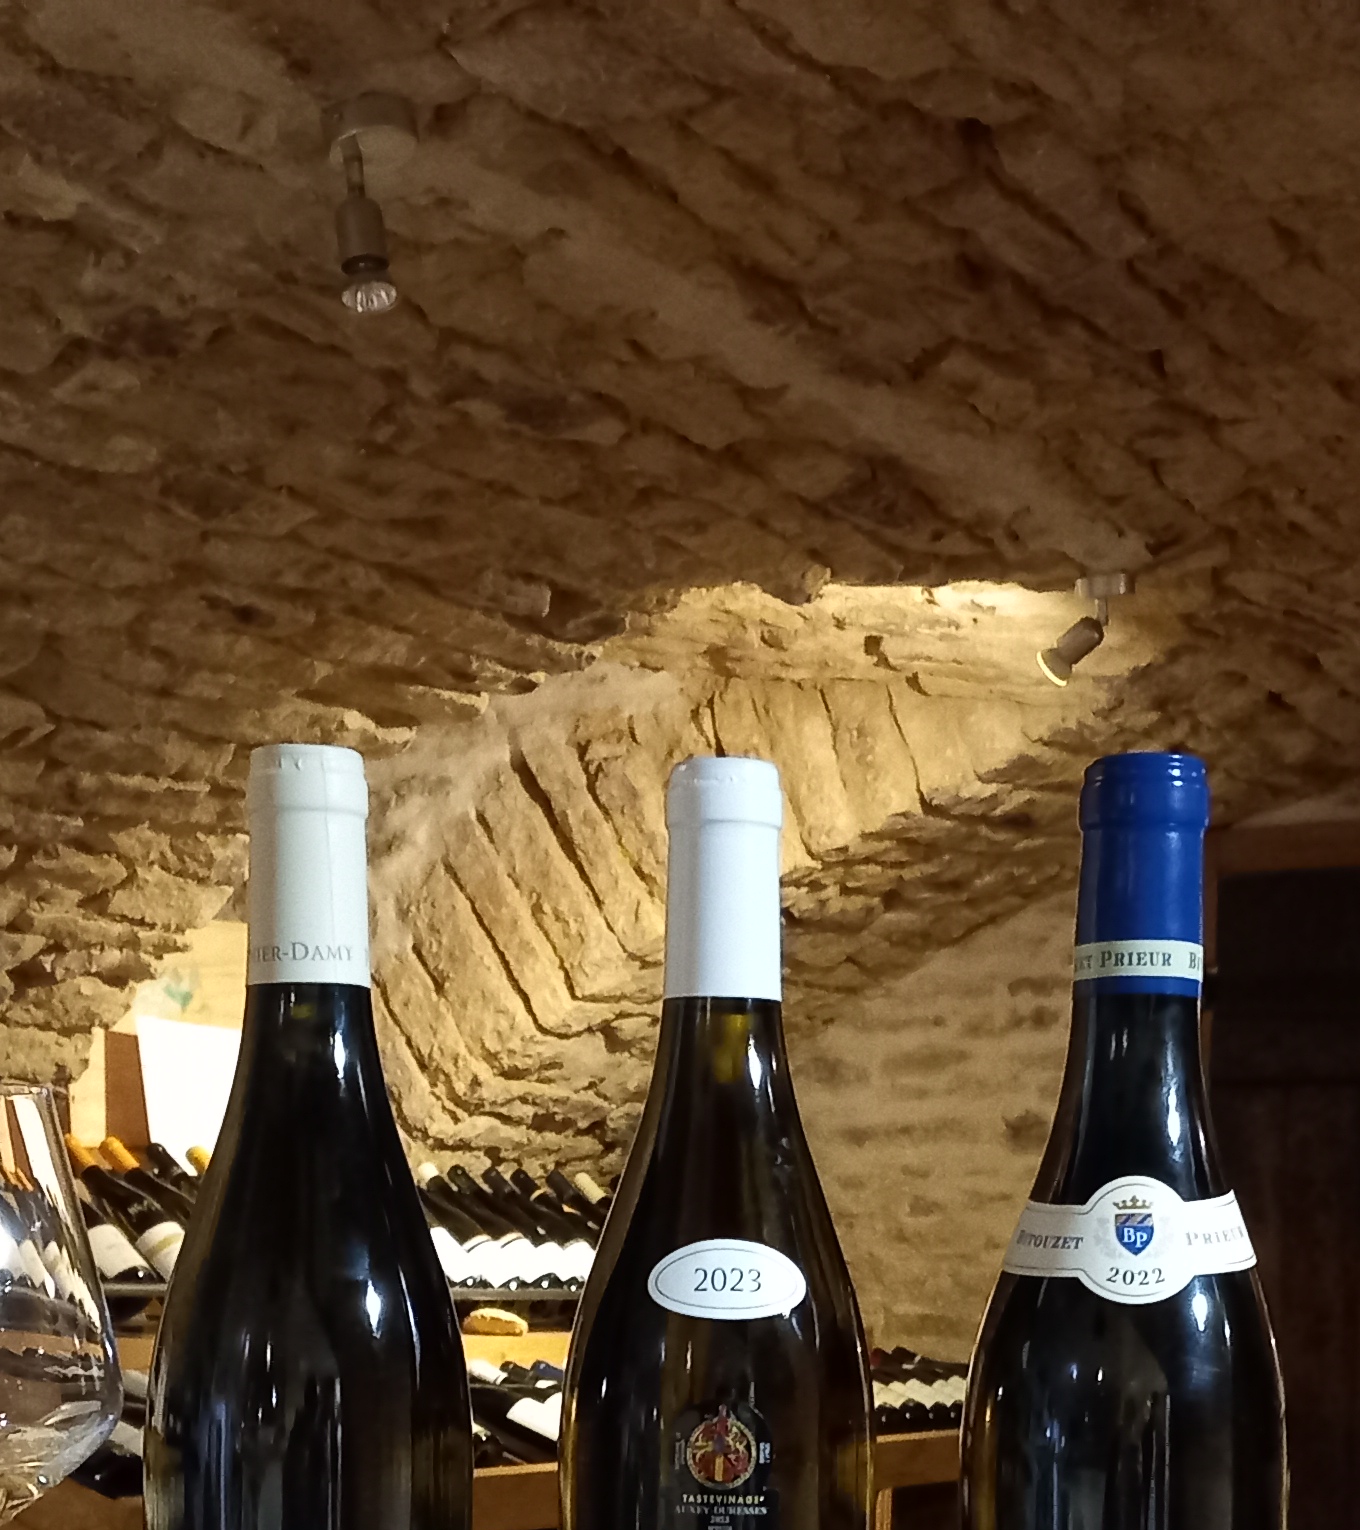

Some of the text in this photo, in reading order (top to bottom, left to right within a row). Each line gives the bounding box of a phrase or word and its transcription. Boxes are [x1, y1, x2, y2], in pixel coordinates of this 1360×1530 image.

[1099, 950, 1172, 968] PRIEUR
[693, 1267, 763, 1293] 2023
[1106, 1266, 1166, 1286] 2022
